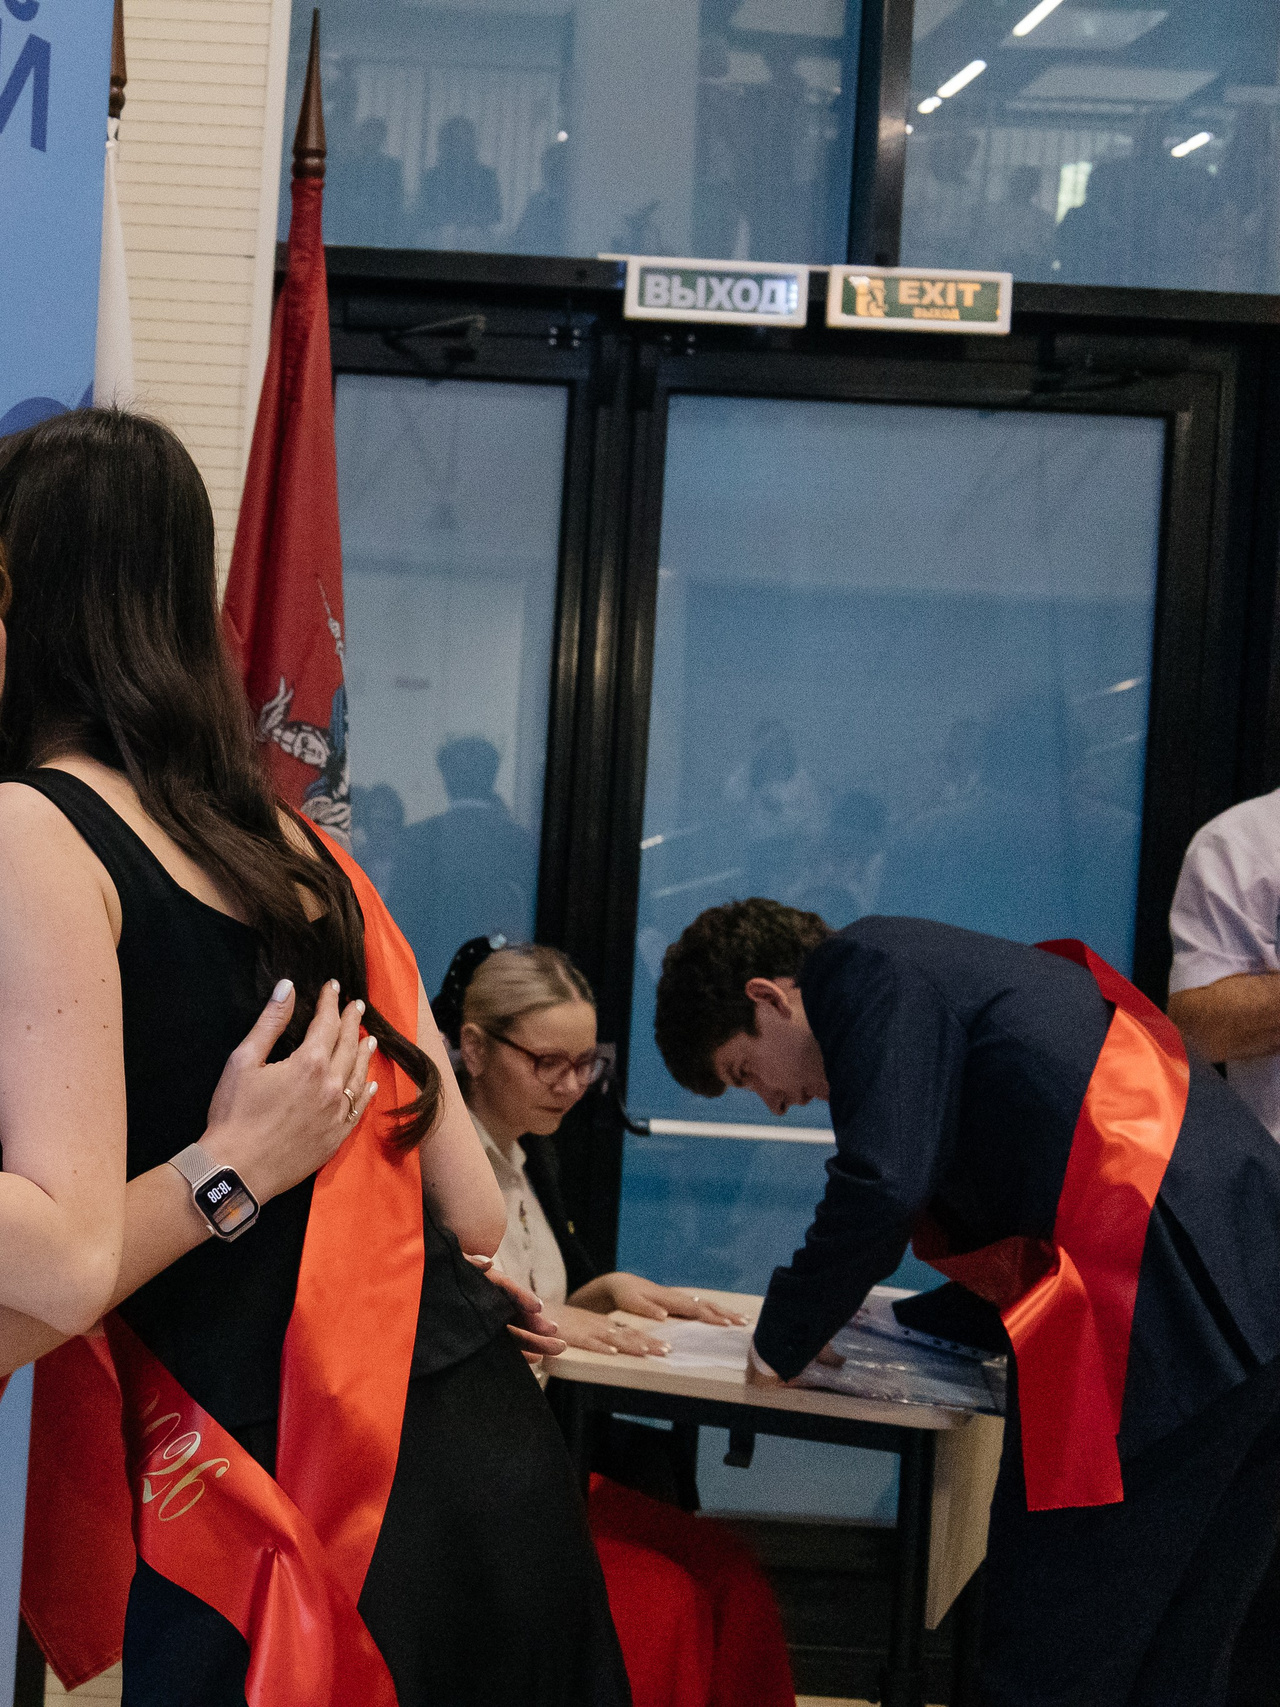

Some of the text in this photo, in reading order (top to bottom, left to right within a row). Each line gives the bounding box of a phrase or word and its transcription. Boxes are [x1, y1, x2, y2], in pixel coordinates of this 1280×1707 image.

[643, 275, 788, 314] ВЫХОД
[898, 280, 982, 308] EXIT
[207, 1180, 232, 1204] 18:08
